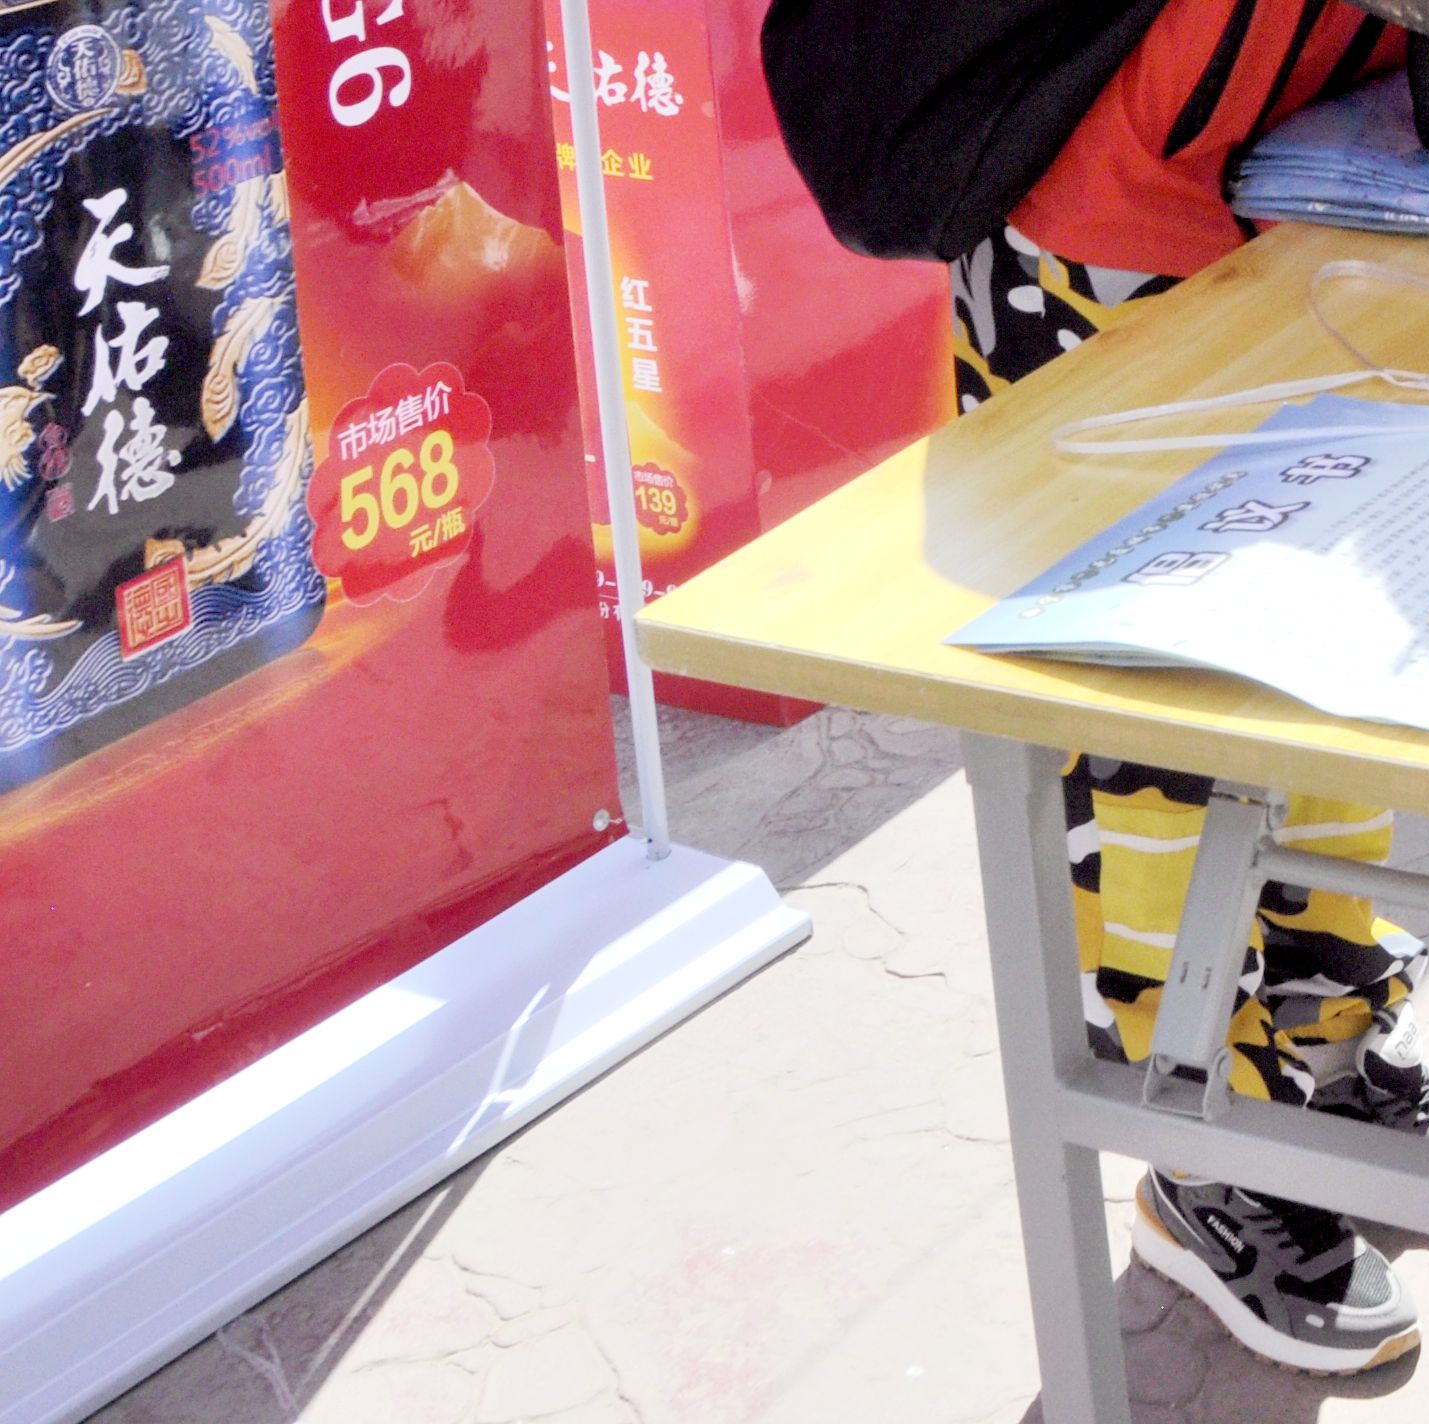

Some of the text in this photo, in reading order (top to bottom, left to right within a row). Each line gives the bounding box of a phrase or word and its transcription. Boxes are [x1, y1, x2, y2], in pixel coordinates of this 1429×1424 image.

[70, 188, 182, 515] 天佑德
[620, 276, 662, 393] 红五星
[338, 380, 452, 461] 市场售价
[341, 430, 460, 551] 568
[409, 506, 466, 558] 元/瓶
[635, 487, 676, 516] 139
